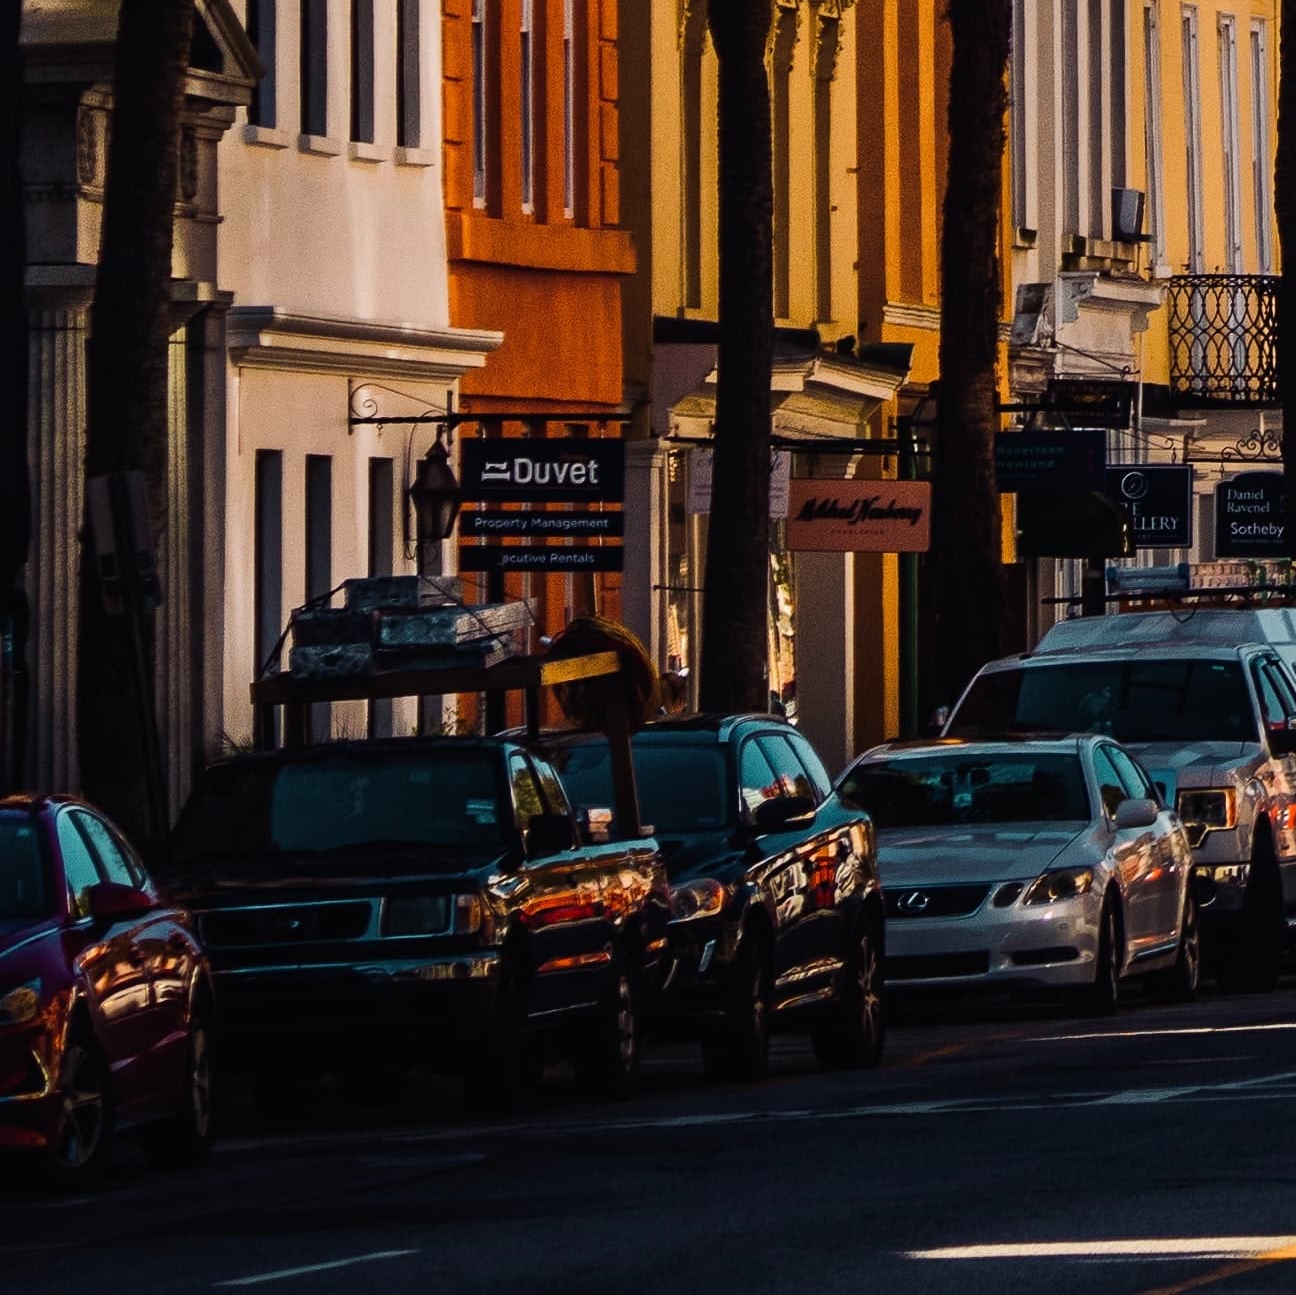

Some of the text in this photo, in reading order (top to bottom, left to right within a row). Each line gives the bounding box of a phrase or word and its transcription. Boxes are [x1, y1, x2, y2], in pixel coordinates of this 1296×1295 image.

[513, 458, 600, 485] Duvet
[1227, 489, 1264, 500] Daniel
[1227, 500, 1271, 513] Ravenel
[474, 517, 609, 533] Property Management
[1133, 516, 1180, 531] LLERY
[502, 552, 595, 564] ecutive Rentals
